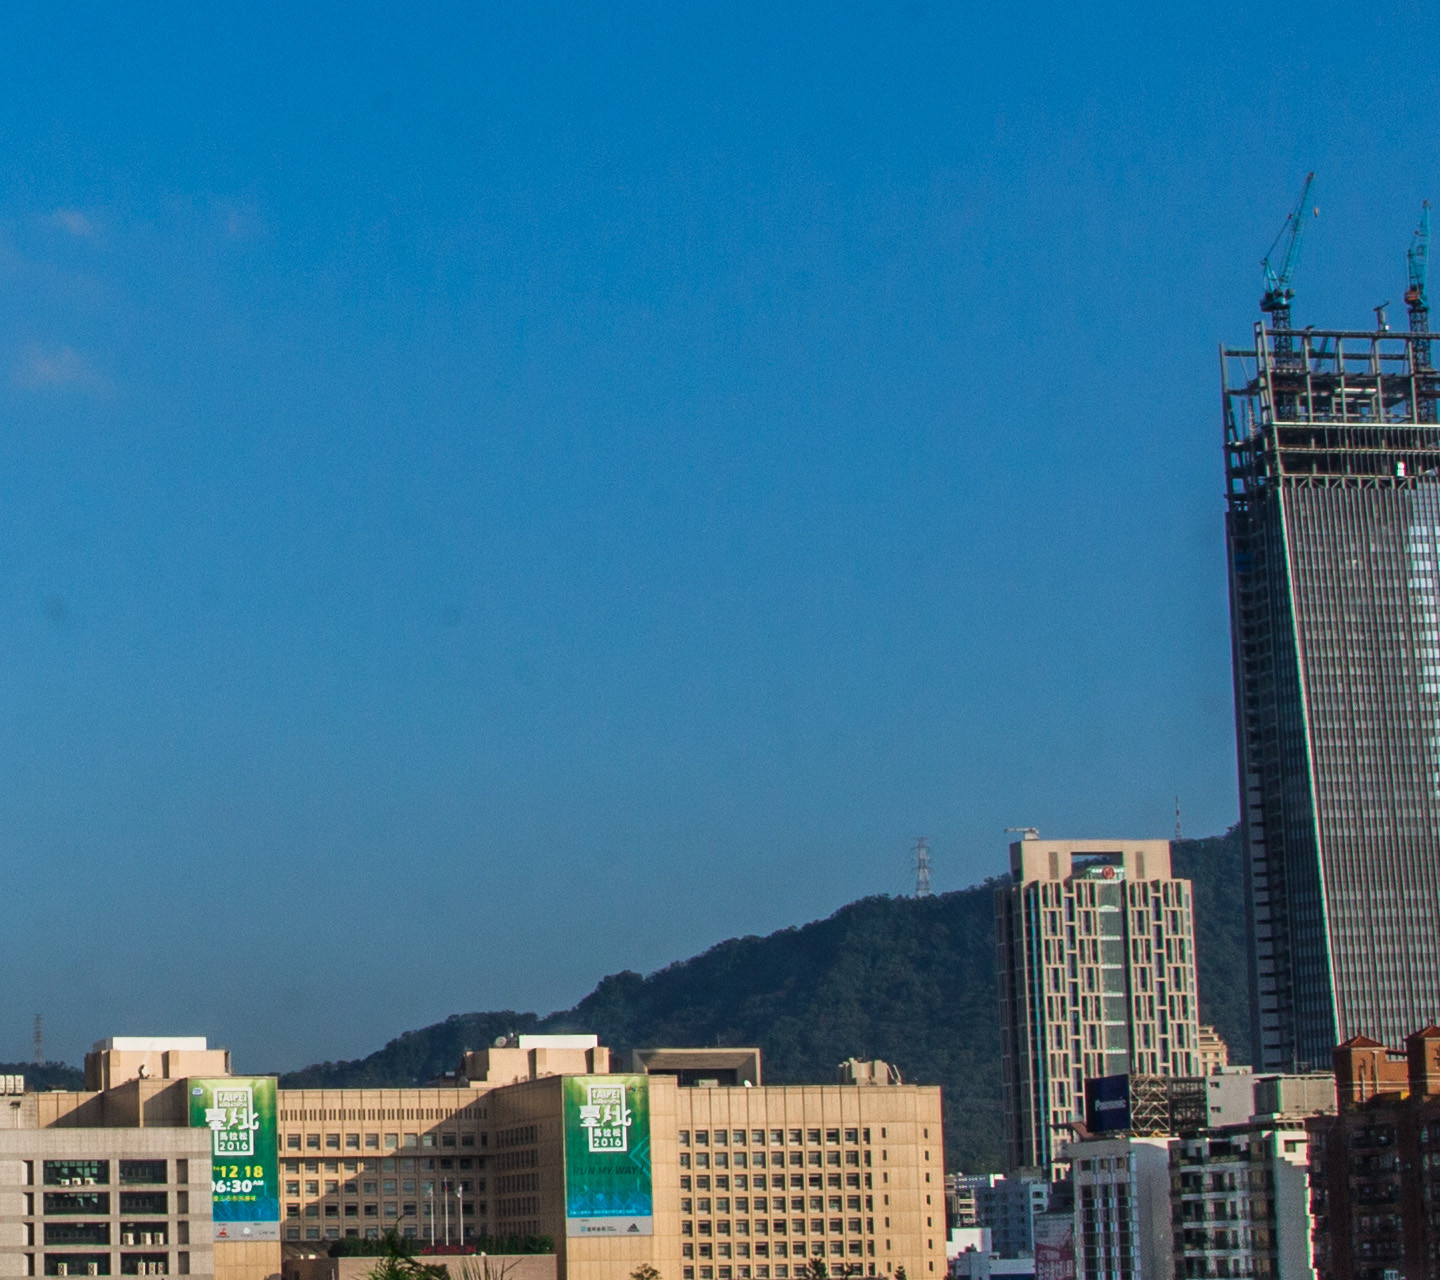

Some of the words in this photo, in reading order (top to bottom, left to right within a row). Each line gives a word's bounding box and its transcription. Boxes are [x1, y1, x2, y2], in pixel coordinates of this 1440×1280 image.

[218, 1093, 247, 1101] TAIPEI
[592, 1090, 620, 1099] TAIPEI
[219, 1141, 248, 1150] 2016
[593, 1138, 621, 1147] 2016
[573, 1165, 595, 1175] RUN
[597, 1165, 613, 1175] MY
